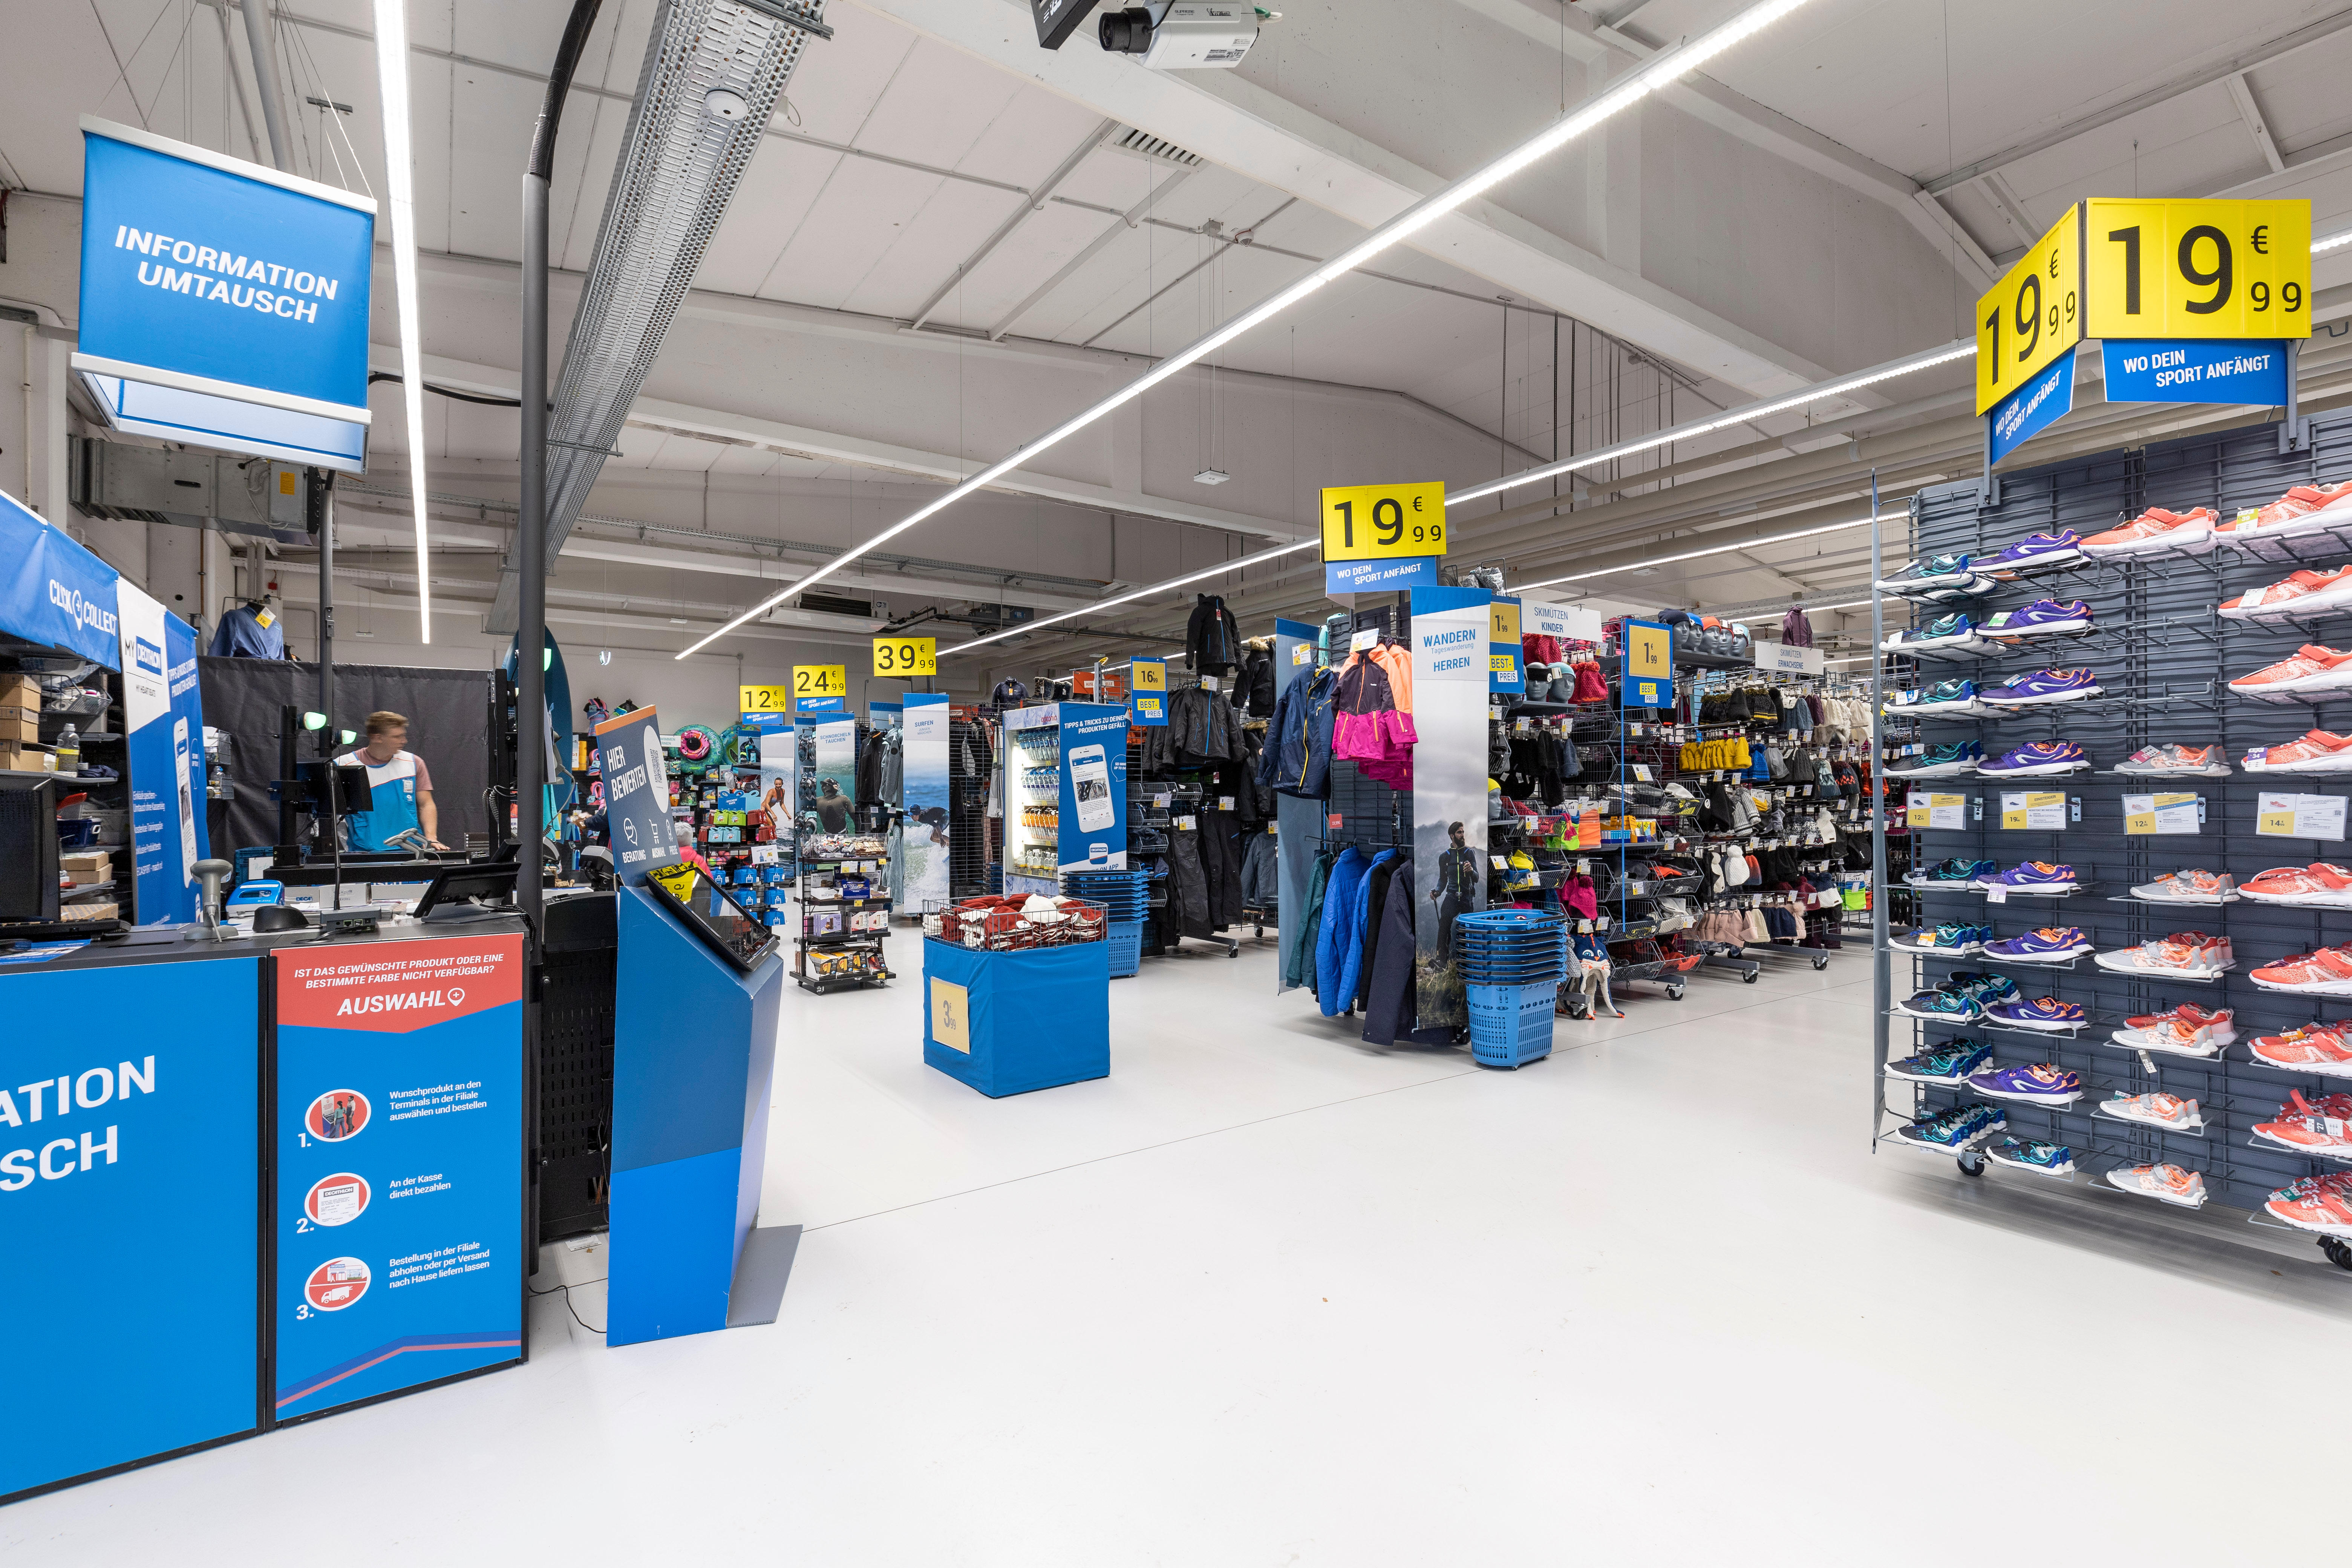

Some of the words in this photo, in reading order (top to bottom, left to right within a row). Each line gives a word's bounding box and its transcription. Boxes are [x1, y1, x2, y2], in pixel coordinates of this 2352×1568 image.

[2251, 225, 2269, 255] €
[115, 225, 338, 300] INFORMATION
[2049, 248, 2059, 279] €
[2109, 225, 2233, 315] 19
[138, 261, 318, 324] UMTAUSCH
[2250, 281, 2302, 313] 99
[2049, 291, 2076, 336] 99
[1986, 273, 2041, 386] 19
[2124, 357, 2148, 374] WO
[2151, 349, 2186, 369] DEIN
[2156, 366, 2200, 387] SPORT
[2206, 355, 2271, 379] ANFÄNGT
[2005, 412, 2026, 441] SPORT
[2026, 369, 2061, 422] ANFÄNGT
[1995, 414, 2005, 437] WO
[2005, 398, 2020, 427] DEIN
[1412, 496, 1423, 512] €
[1334, 498, 1404, 548] 19
[1413, 525, 1442, 542] 99
[1337, 567, 1351, 579] WO
[1352, 564, 1372, 577] DEIN
[1354, 571, 1381, 585] SPORT
[1383, 563, 1421, 581] ANFÄNGT
[49, 579, 73, 614] CLICK
[83, 601, 117, 636] COLLECT
[1534, 606, 1568, 620] SKIMÜTZEN
[1495, 615, 1500, 632] 1
[1541, 622, 1563, 633] KINDER
[125, 638, 135, 658] MY
[1423, 629, 1476, 648] WANDERN
[877, 644, 915, 670] 39
[920, 644, 925, 653] €
[1431, 642, 1474, 655] Tageswanderung
[1643, 642, 1649, 663] 1
[1651, 655, 1657, 664] 99
[1780, 648, 1802, 658] SKIMÜTZEN
[920, 659, 934, 669] 99
[1433, 656, 1470, 672] HERREN
[1491, 658, 1511, 668] BEST-
[1778, 659, 1804, 670] ERWACHSENE
[796, 671, 829, 692] 24
[831, 683, 844, 691] 99
[1141, 671, 1153, 683] 16
[1500, 672, 1516, 681] PREIS
[745, 691, 771, 708] 12
[1139, 700, 1157, 708] BEST-
[820, 731, 851, 740] SCHNORCHELN
[1078, 724, 1107, 734] PRODUKTEN
[606, 745, 626, 772] HIER
[611, 764, 647, 802] BEWERTEN
[622, 849, 646, 864] BERATUNG
[652, 847, 666, 859] AUSWAHL
[669, 845, 678, 856] PREISE
[295, 969, 312, 978] IST
[314, 967, 335, 976] DAS
[337, 961, 407, 974] GEWÜNSCHTE
[409, 958, 455, 969] PRODUKT
[456, 956, 481, 965] ODER
[483, 954, 504, 963] EINE
[305, 976, 366, 989] BESTIMMTE
[368, 973, 400, 983] FARBE
[402, 971, 433, 980] NICHT
[434, 965, 494, 978] VERFÜGBAR?
[337, 990, 446, 1016] AUSWAHL
[943, 1000, 950, 1027] 3
[950, 1018, 956, 1030] 99
[0, 1055, 155, 1127] ATION
[389, 1083, 453, 1099] Wunschprodukt
[466, 1081, 481, 1089] den
[389, 1098, 430, 1110] Terminals
[432, 1096, 439, 1105] in
[441, 1094, 453, 1103] der
[455, 1091, 478, 1101] Filiale
[389, 1107, 433, 1121] auswählen
[435, 1106, 450, 1115] und
[452, 1100, 487, 1112] bestellen
[298, 1133, 311, 1148] 1.
[0, 1125, 117, 1191] SCH
[389, 1180, 401, 1188] An
[403, 1177, 416, 1186] der
[418, 1172, 443, 1183] Kasse
[325, 1187, 353, 1196] DECATHLON
[389, 1188, 412, 1199] direkt
[414, 1181, 451, 1195] bezahlen
[296, 1218, 314, 1234] 2.
[389, 1251, 432, 1267] Bestellung
[434, 1248, 441, 1257] in
[443, 1245, 456, 1256] der
[457, 1241, 480, 1253] Filiale
[389, 1265, 422, 1279] abholen
[424, 1261, 442, 1272] oder
[444, 1259, 457, 1271] per
[458, 1249, 490, 1264] Versand
[389, 1278, 409, 1289] nach
[411, 1272, 438, 1285] Hause
[439, 1267, 464, 1279] liefern
[465, 1261, 490, 1274] lassen
[296, 1304, 314, 1320] 3.
